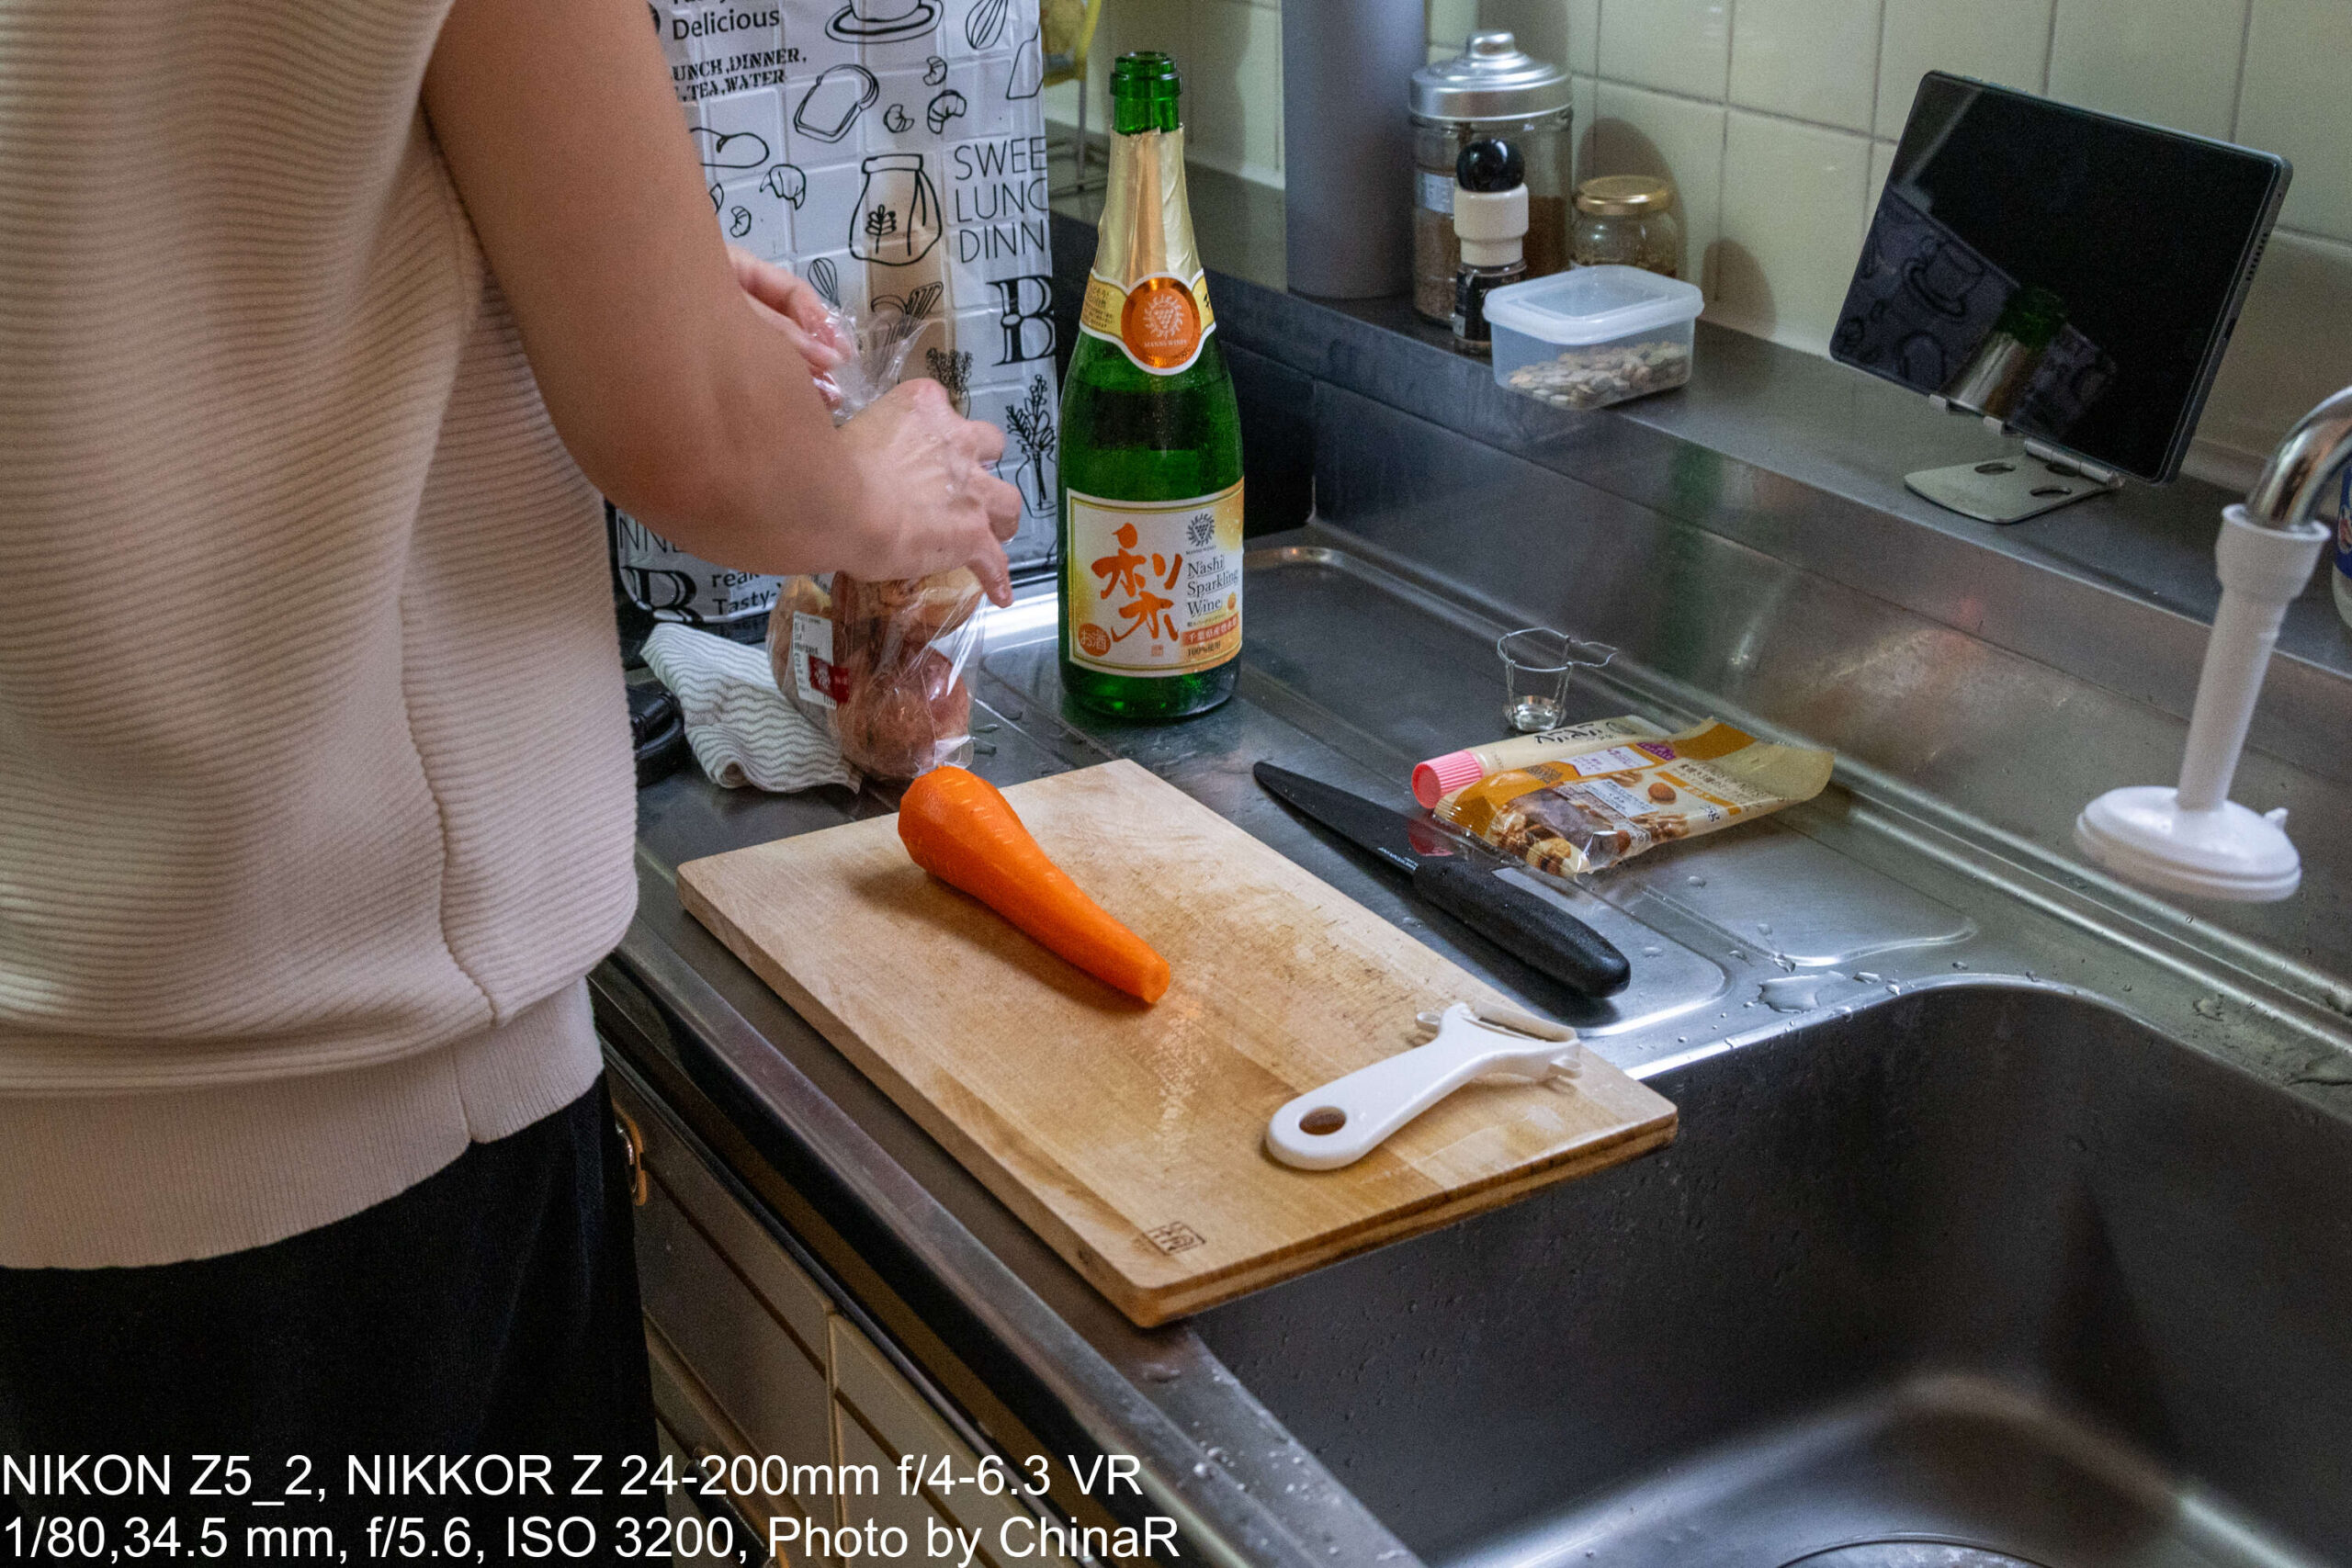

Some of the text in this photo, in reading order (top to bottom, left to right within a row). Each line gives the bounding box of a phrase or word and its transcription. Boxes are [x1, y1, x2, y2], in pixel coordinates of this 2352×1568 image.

[672, 8, 780, 40] Delicious
[955, 137, 1046, 181] SWEE
[956, 177, 1048, 223] LUNC
[959, 219, 1045, 264] DINN
[986, 275, 1057, 367] B
[1091, 522, 1183, 642] 梨
[1187, 554, 1225, 578] Nashi
[1187, 569, 1238, 598] Sparkling
[1187, 598, 1222, 616] Wine
